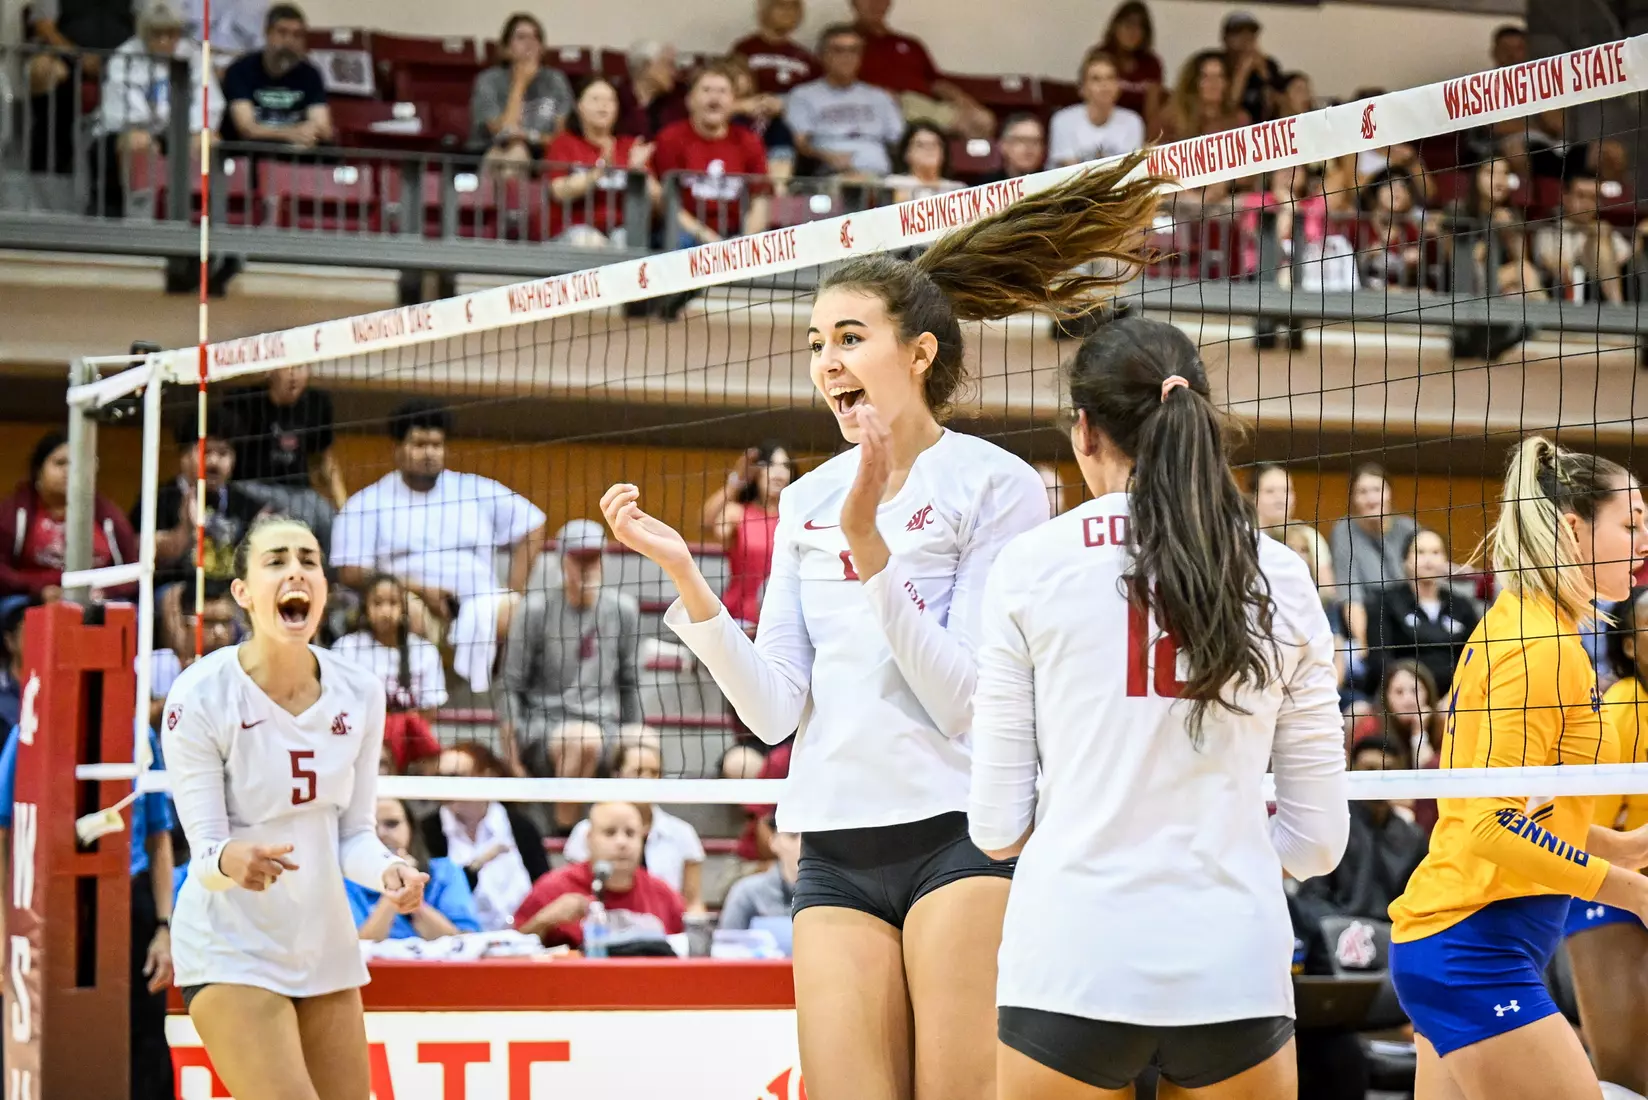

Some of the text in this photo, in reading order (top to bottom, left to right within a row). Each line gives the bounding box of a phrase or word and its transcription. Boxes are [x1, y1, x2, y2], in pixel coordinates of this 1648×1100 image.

[1443, 41, 1627, 121] WASHINGTON STATE
[1146, 117, 1299, 179] WASHINGTON STATE
[898, 188, 982, 237] WASHINGTON
[688, 228, 796, 278] WASHINGTON STATE
[288, 749, 317, 806] 5
